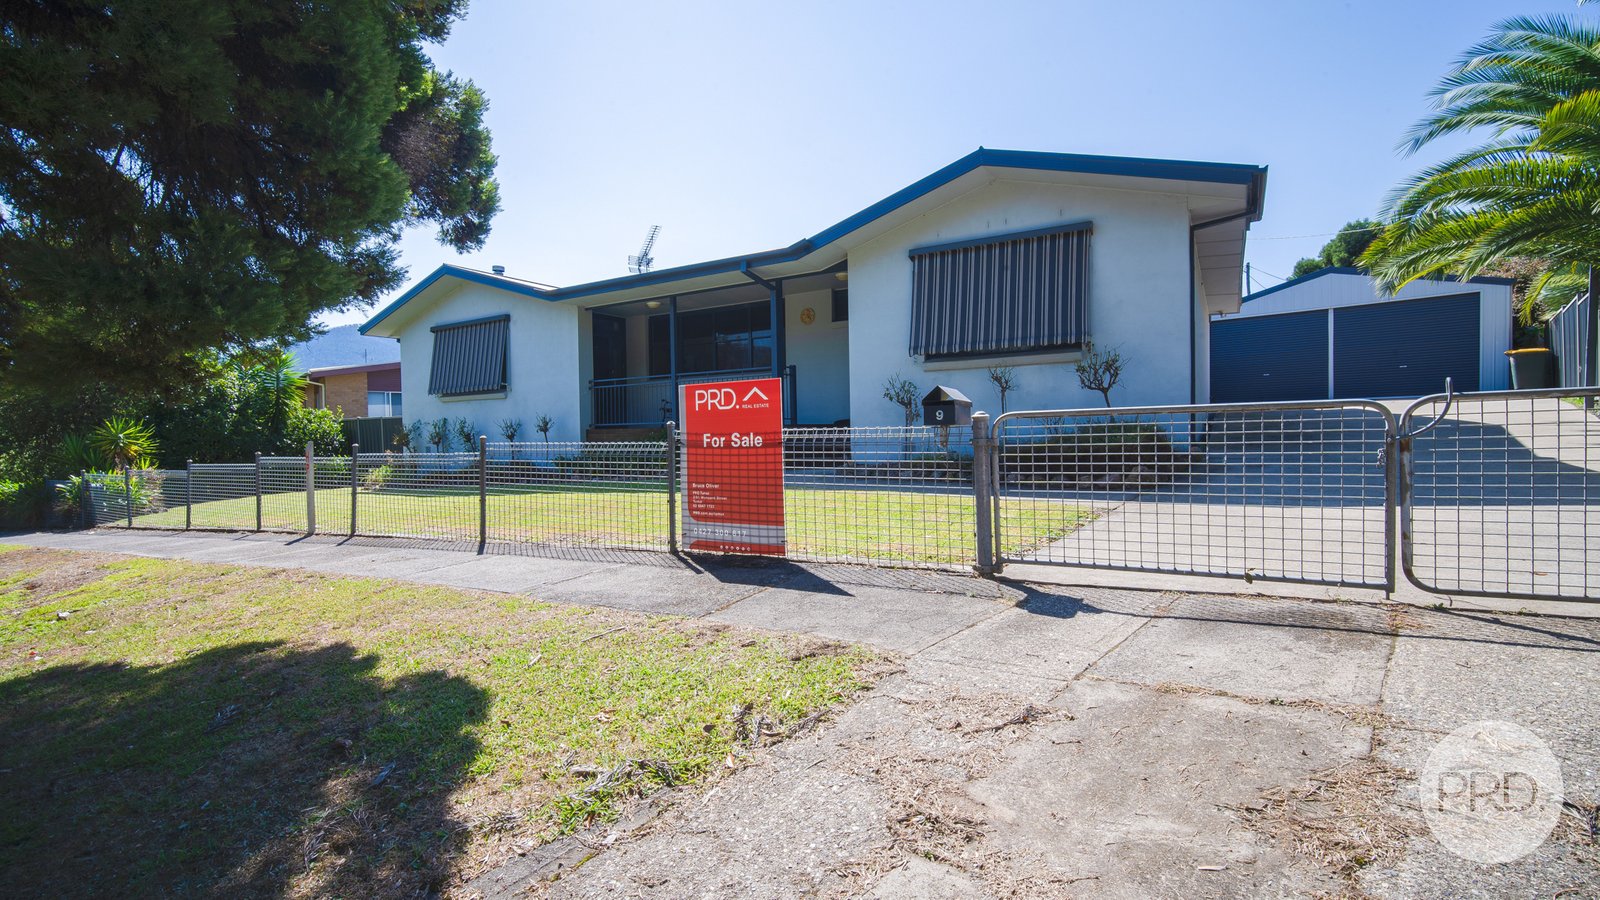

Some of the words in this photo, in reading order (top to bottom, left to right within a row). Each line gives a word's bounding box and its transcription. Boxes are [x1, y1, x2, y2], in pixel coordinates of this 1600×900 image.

[935, 410, 944, 420] 9
[703, 433, 725, 447] For
[731, 432, 763, 447] Sale
[715, 529, 729, 537] 300
